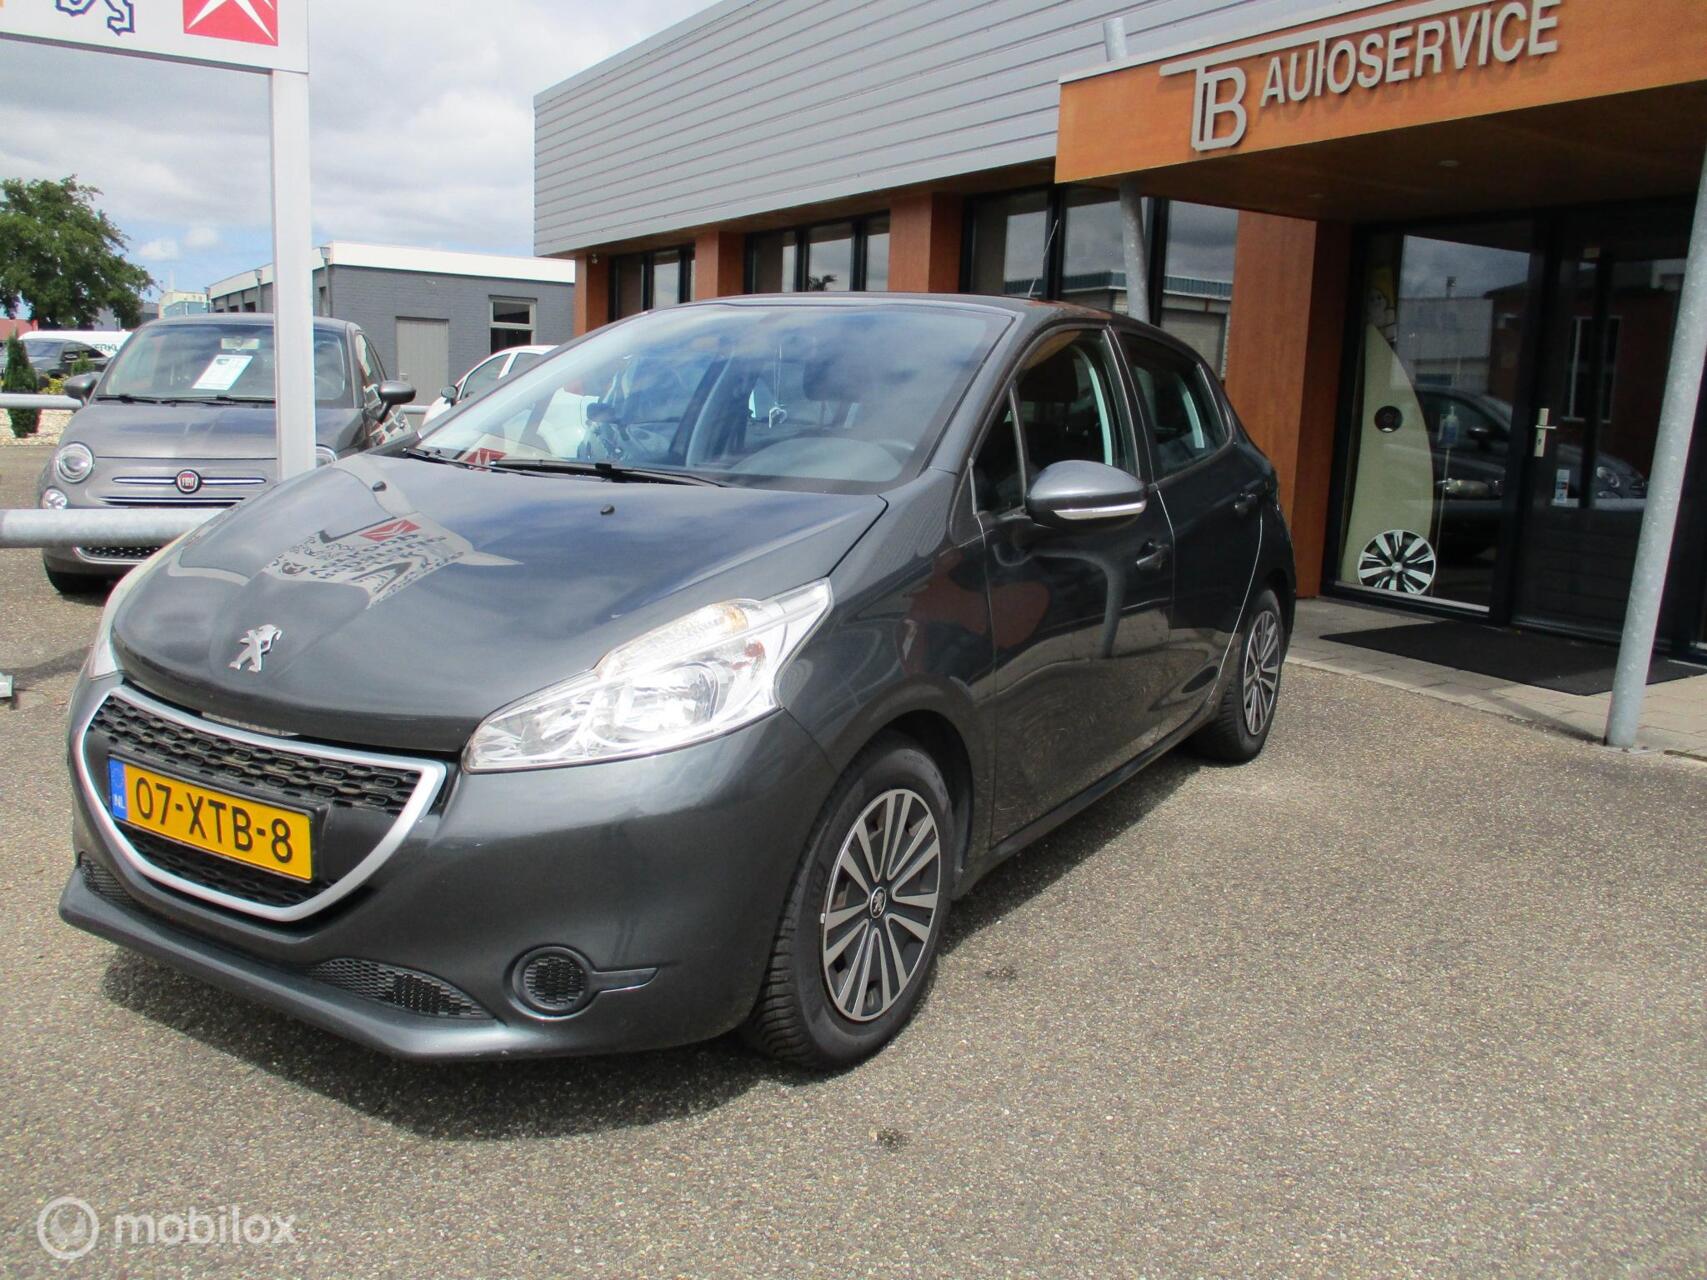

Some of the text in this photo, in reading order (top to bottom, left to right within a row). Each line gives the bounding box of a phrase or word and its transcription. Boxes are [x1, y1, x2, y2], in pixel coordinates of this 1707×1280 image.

[1260, 0, 1561, 107] AUTOSERVICE
[112, 776, 293, 864] NL 07-XTB-8
